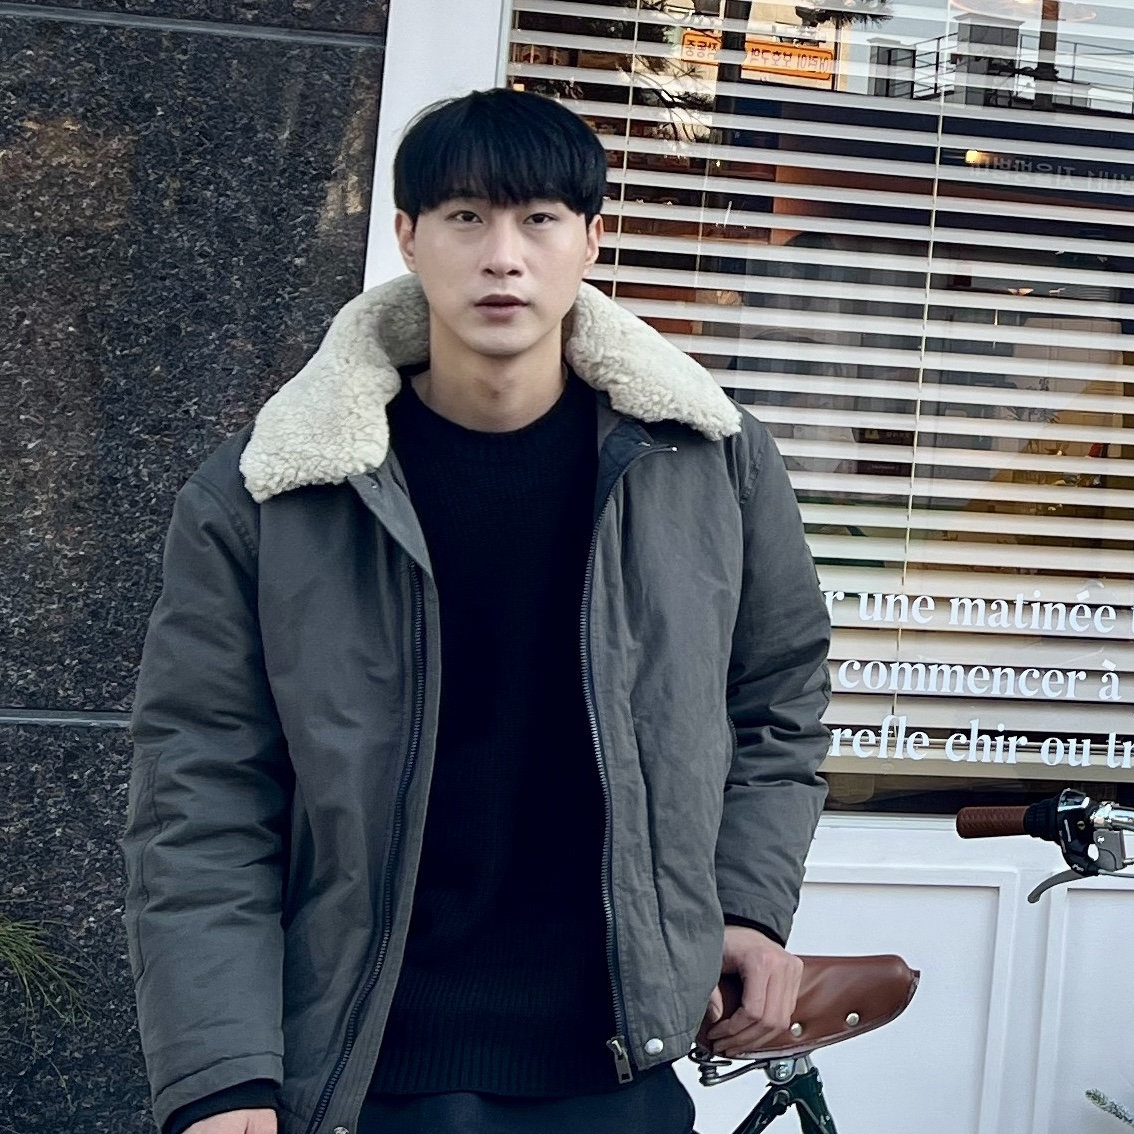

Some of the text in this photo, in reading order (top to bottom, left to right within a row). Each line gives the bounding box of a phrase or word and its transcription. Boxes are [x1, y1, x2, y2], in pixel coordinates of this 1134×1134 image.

[858, 591, 934, 625] une
[950, 589, 1116, 636] matinée
[838, 658, 1087, 698] commencer
[1098, 658, 1122, 702] à
[945, 717, 1028, 765] chir
[1040, 733, 1092, 768] ou
